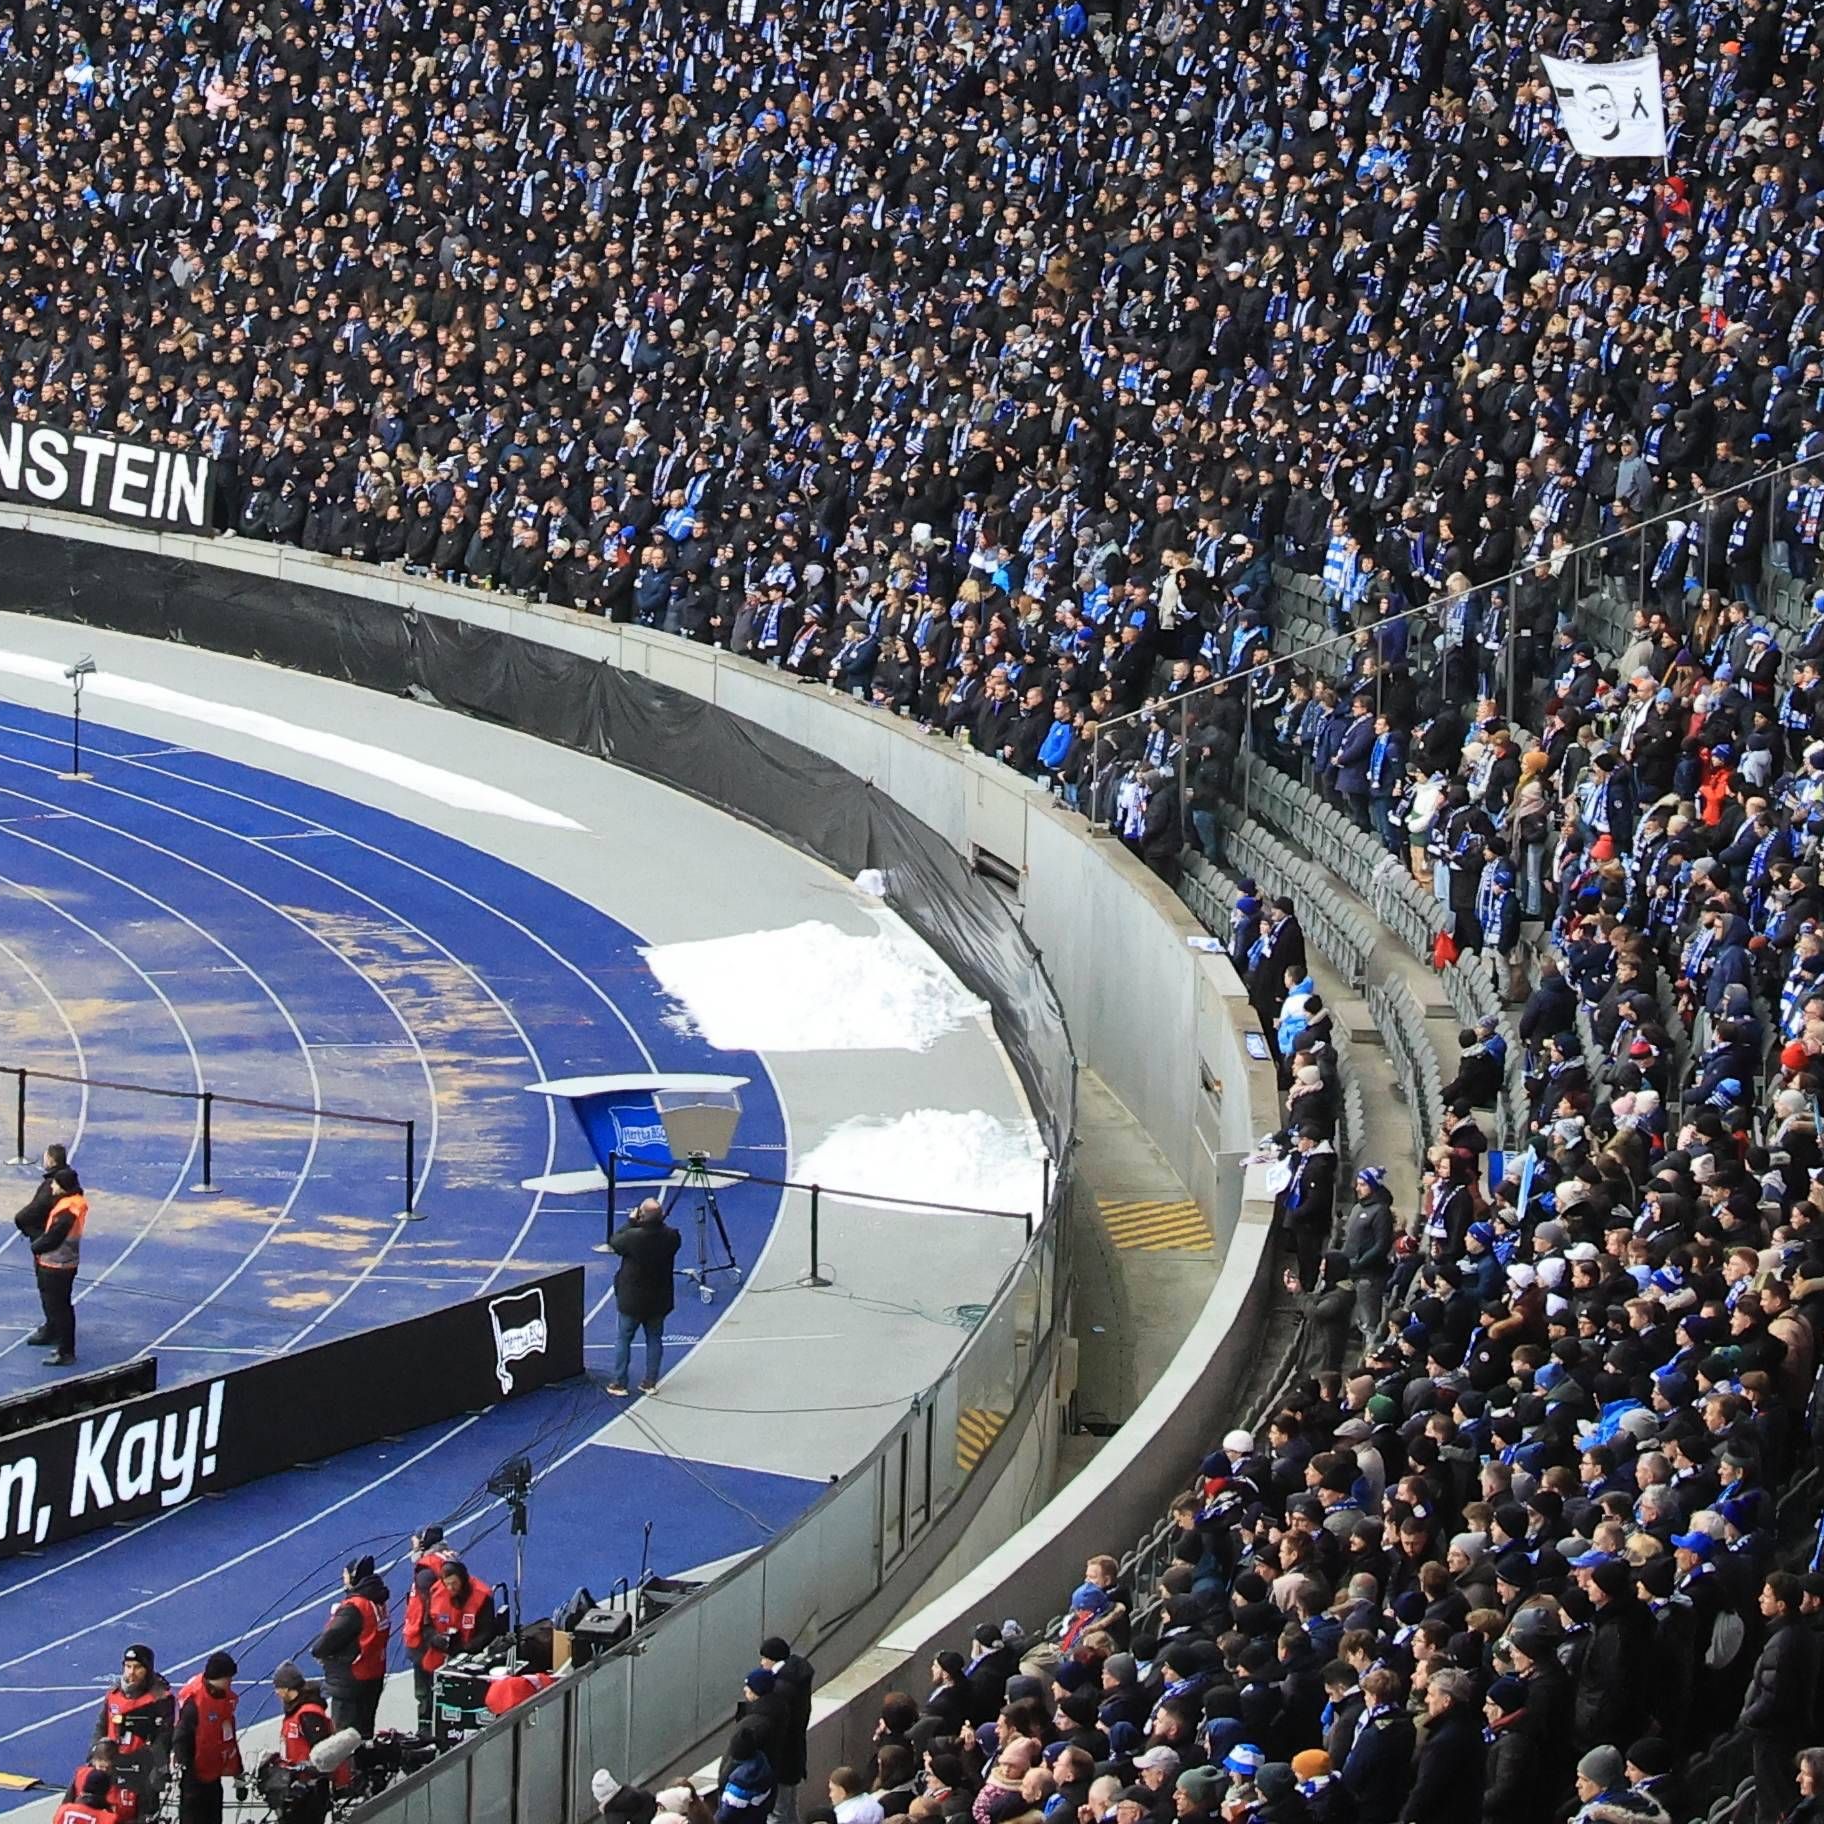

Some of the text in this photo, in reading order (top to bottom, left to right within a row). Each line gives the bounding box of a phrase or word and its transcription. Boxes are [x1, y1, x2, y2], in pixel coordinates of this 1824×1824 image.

[623, 1128, 650, 1143] Hertha
[70, 1380, 226, 1517] Kay!
[447, 1728, 464, 1741] sky
